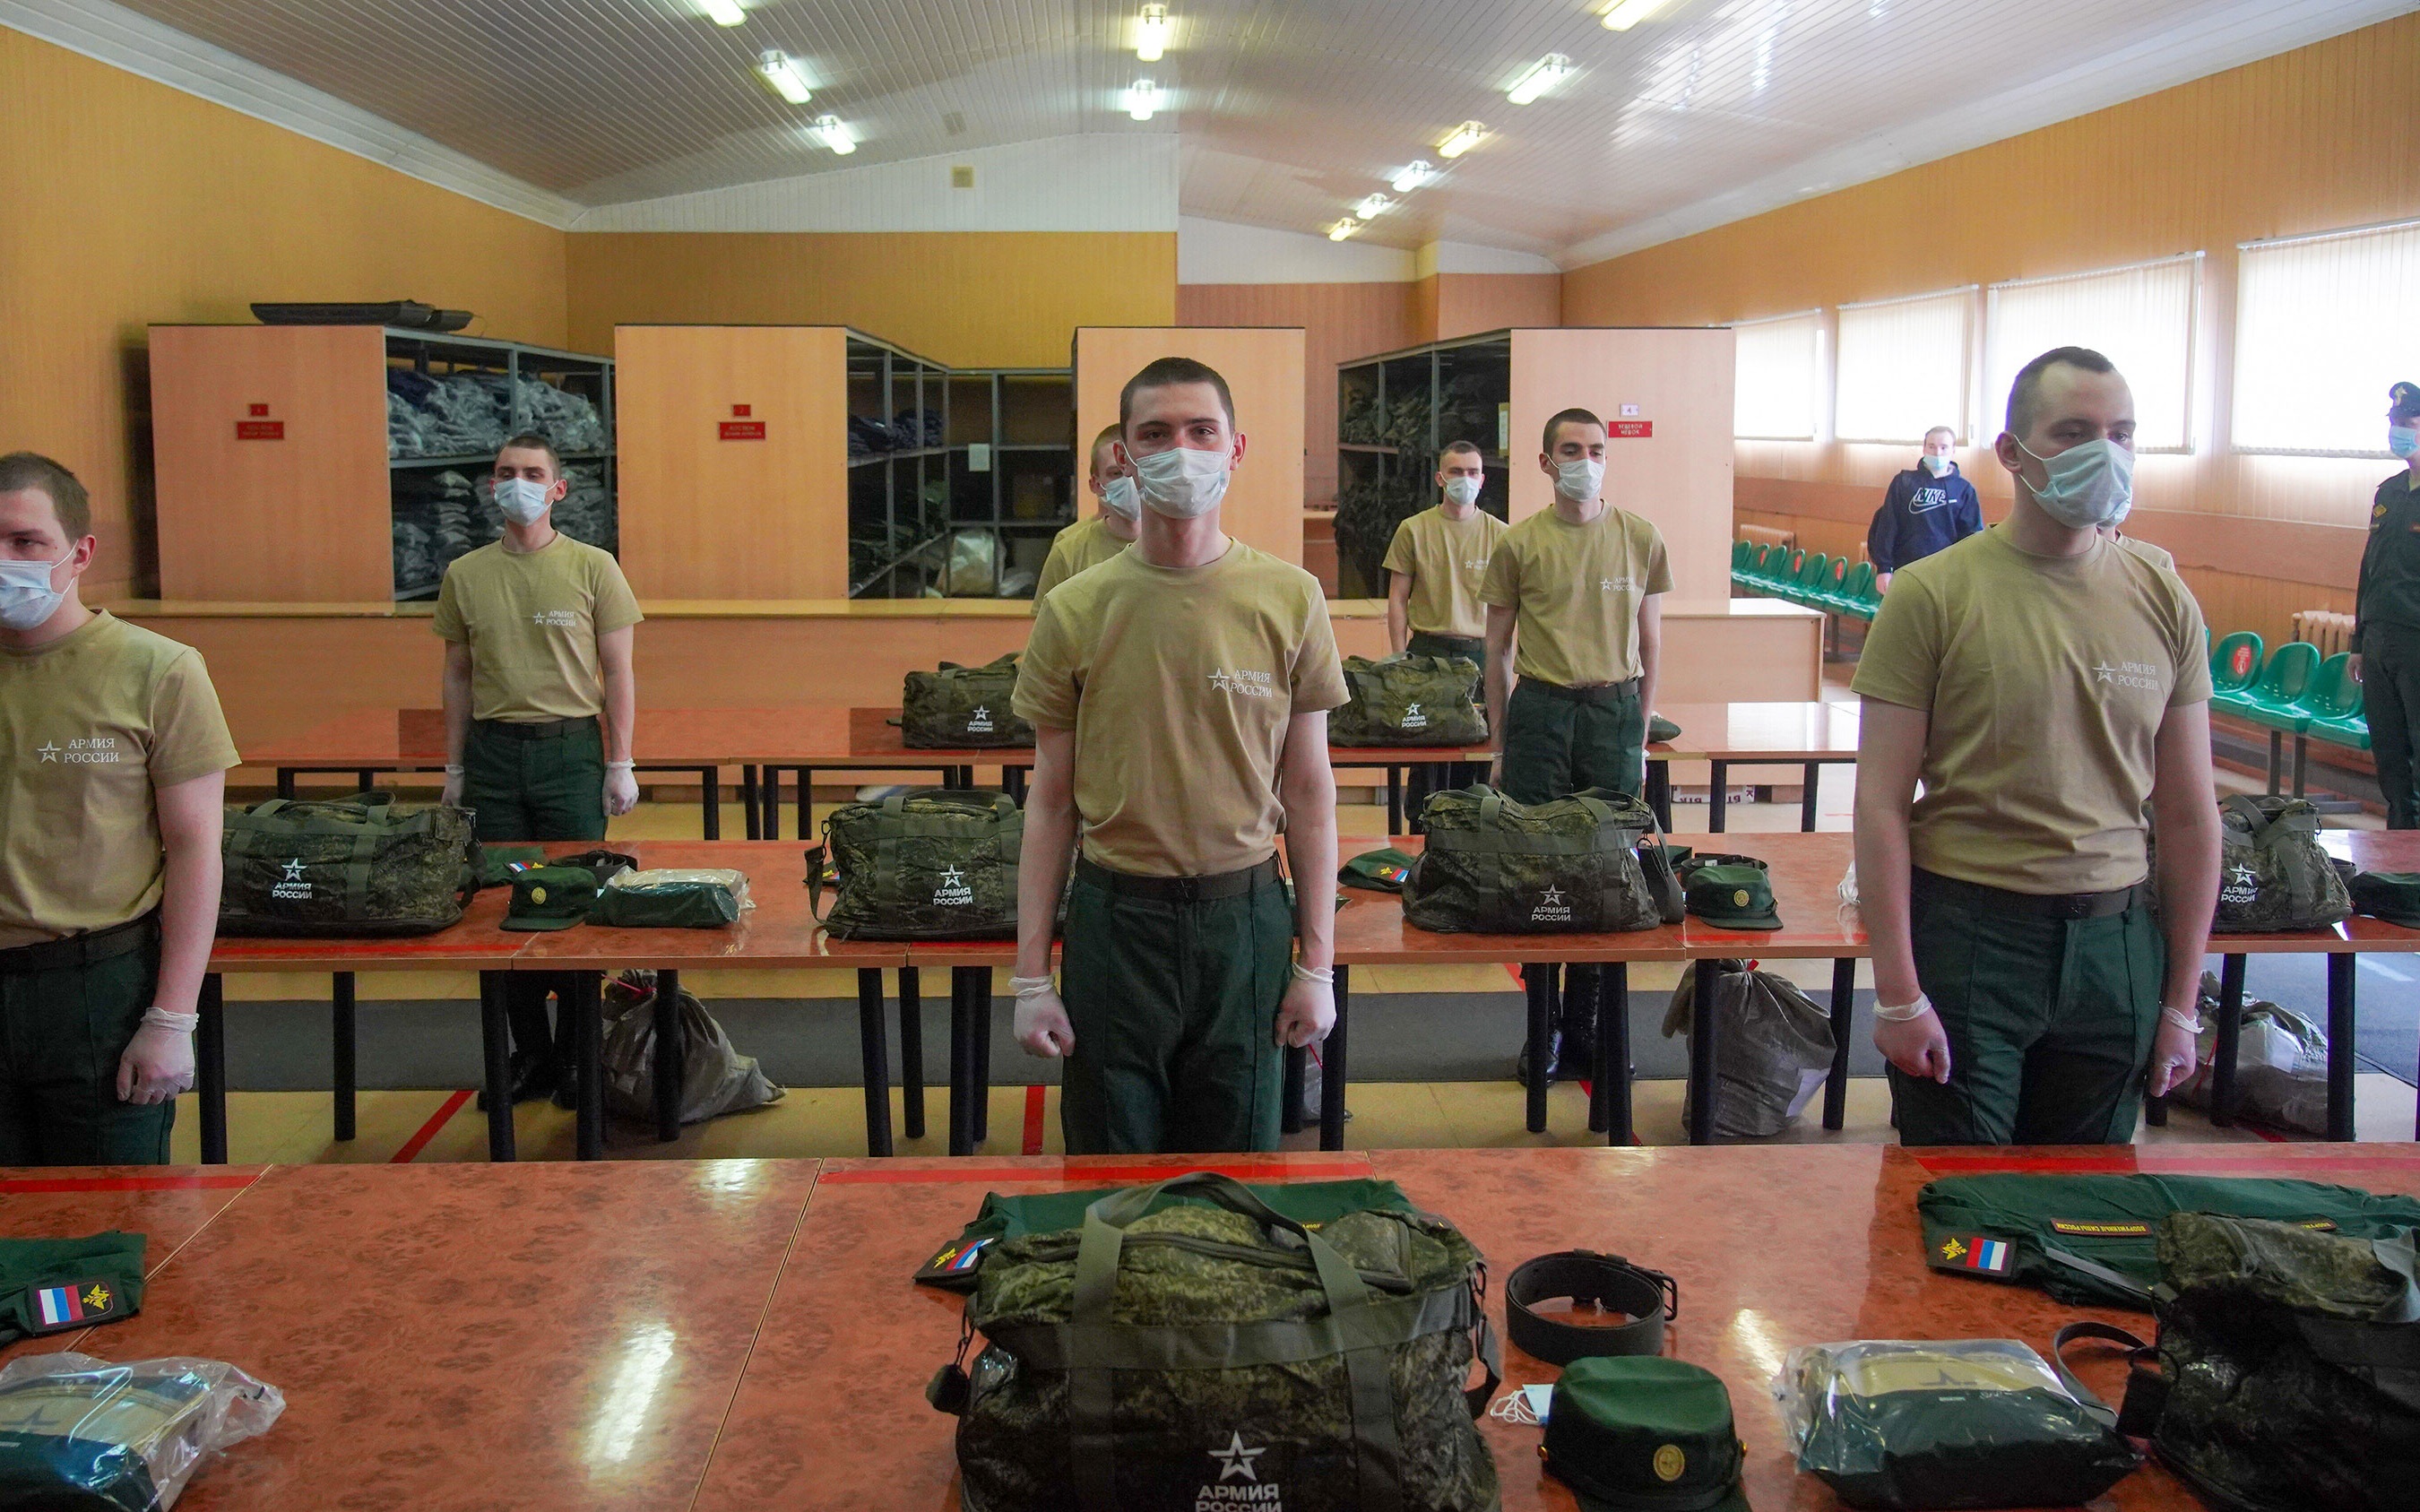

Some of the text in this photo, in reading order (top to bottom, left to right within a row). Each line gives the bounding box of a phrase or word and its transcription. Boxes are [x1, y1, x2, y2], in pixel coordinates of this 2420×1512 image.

[1914, 488, 1946, 503] NIKE
[2121, 661, 2156, 675] АРМИЯ
[1234, 670, 1271, 683] АРМИЯ
[2117, 675, 2158, 690] РОССИИ
[1230, 683, 1273, 697] РОССИИ
[68, 739, 115, 749] АРМИЯ
[65, 752, 119, 764] РОССИИ
[274, 882, 312, 891] АРМИЯ
[934, 886, 972, 897] АРМИЯ
[272, 890, 313, 899] РОССИИ
[933, 896, 973, 906] РОССИИ
[1533, 906, 1570, 914] АРМИЯ
[1197, 1483, 1280, 1501] АРМИЯ
[1195, 1500, 1283, 1512] РОССИИ
